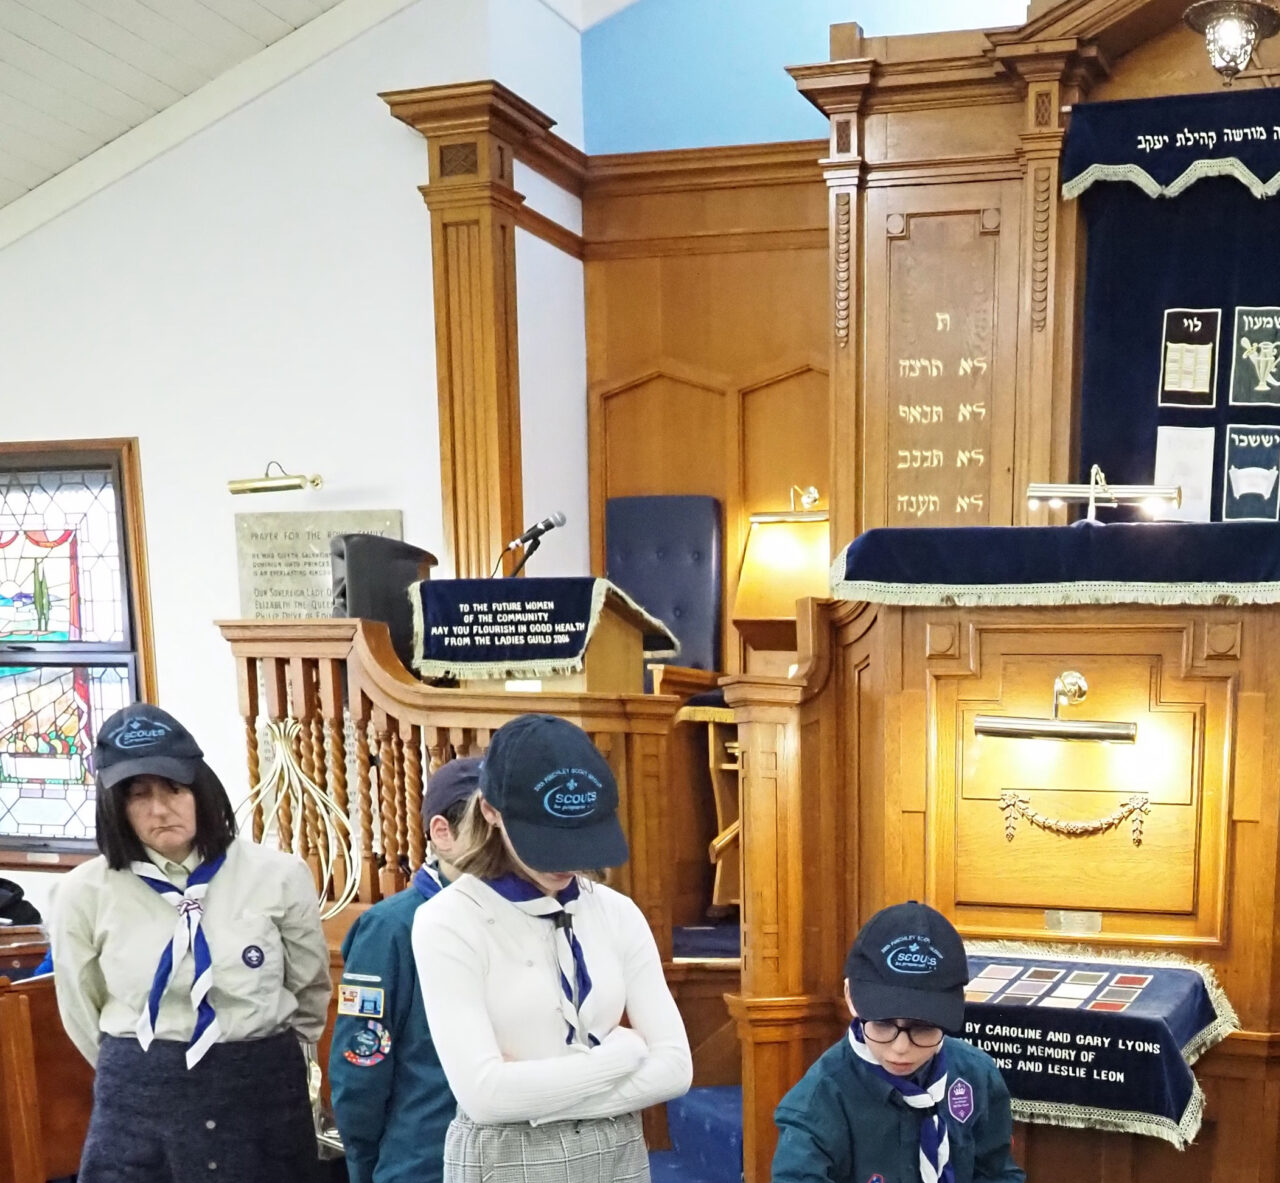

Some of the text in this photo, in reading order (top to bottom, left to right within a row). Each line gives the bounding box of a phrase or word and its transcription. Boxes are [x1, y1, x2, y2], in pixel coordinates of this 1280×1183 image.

[1175, 128, 1217, 149] קהילת
[1224, 126, 1267, 142] מורשה
[1137, 135, 1169, 152] יעקב
[1183, 317, 1202, 332] לוי
[899, 357, 987, 377] לא תרצח
[899, 402, 986, 423] לא תנאף
[1231, 434, 1280, 447] יששכר
[956, 449, 984, 467] לא
[897, 494, 984, 517] לא תענה
[251, 532, 278, 540] PRAYER
[284, 531, 299, 540] FOR
[307, 531, 320, 540] THE
[459, 601, 554, 612] TO THE FUTURE WOMEN
[464, 612, 548, 623] OF THE COMMUNITY
[431, 622, 585, 635] MAY YOU FLOURISH IN GOOD HEALTH
[444, 637, 471, 646] FROM
[475, 636, 490, 645] THE
[495, 635, 524, 645] LADIES
[527, 635, 551, 644] GUILD
[966, 1022, 1161, 1054] BY CAROLINE AND GARY LYONS
[977, 1040, 1022, 1054] LOVING
[1027, 1045, 1077, 1061] MEMORY
[1080, 1051, 1096, 1063] OF
[1017, 1061, 1043, 1073] AND
[1048, 1064, 1086, 1078] LESLIE
[1093, 1069, 1125, 1083] LEON
